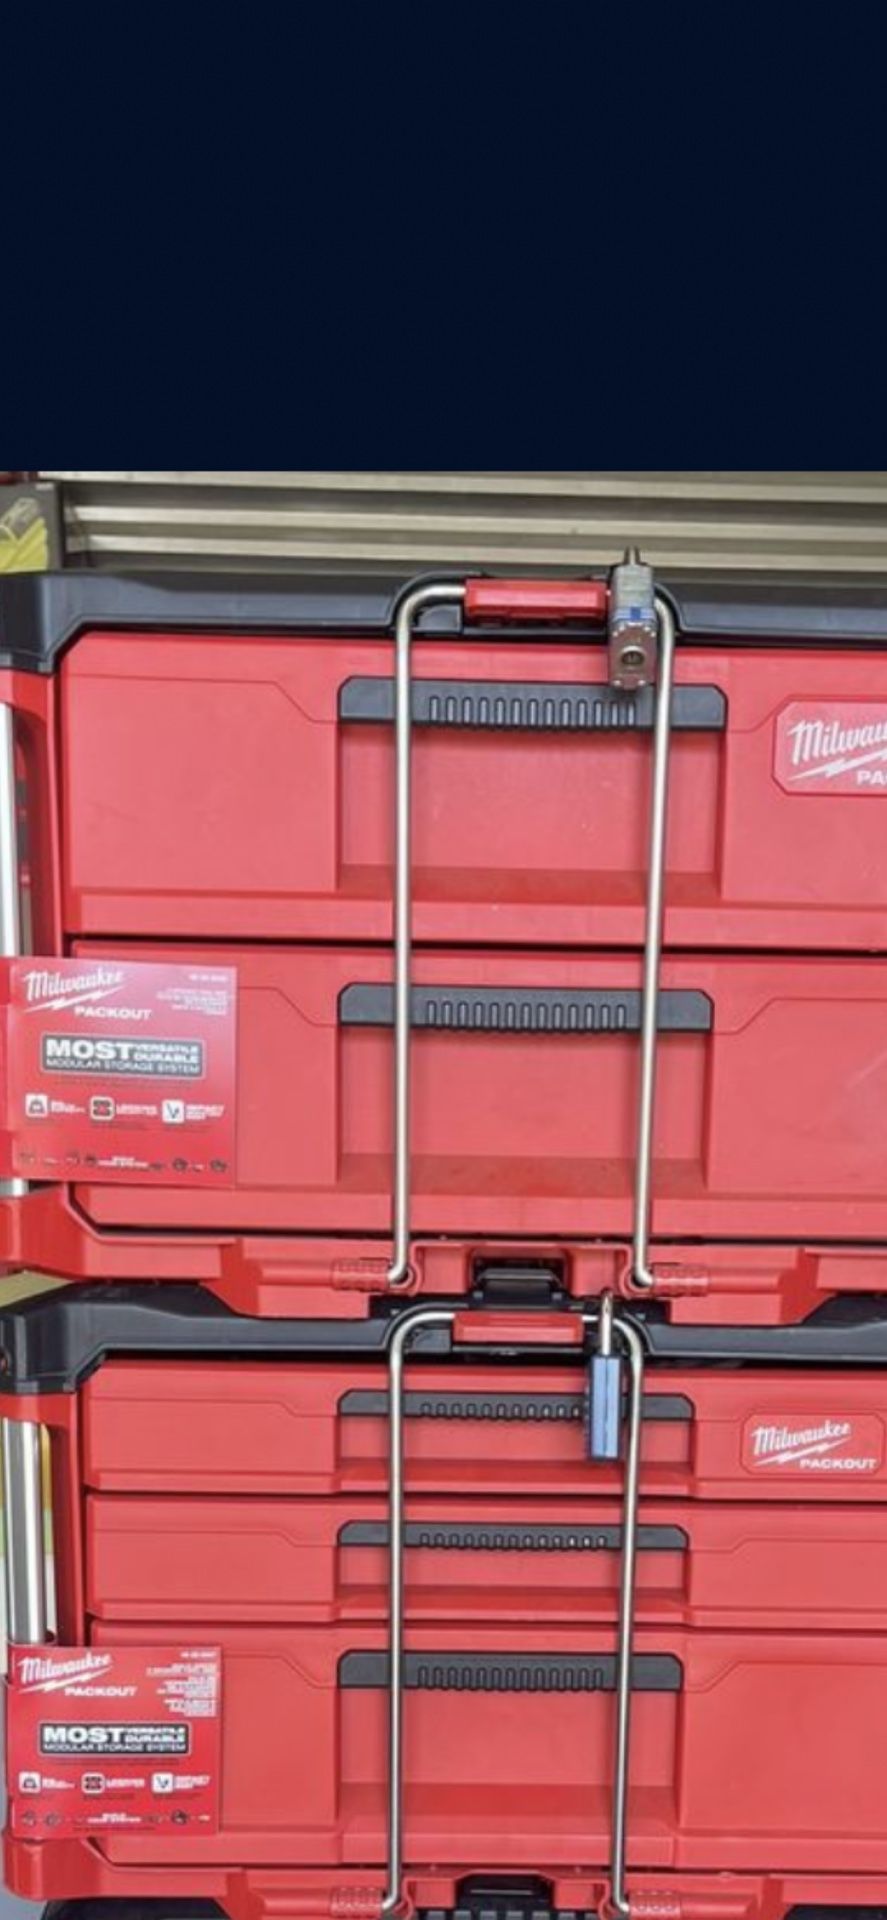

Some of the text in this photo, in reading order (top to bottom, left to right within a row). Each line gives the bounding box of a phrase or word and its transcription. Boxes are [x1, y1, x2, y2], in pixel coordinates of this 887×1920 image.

[857, 770, 887, 785] PA
[24, 968, 123, 1002] Milwaukee
[74, 1006, 152, 1020] PACKOUT
[46, 1038, 133, 1060] MOST
[134, 1043, 199, 1054] VERSATILE
[133, 1052, 199, 1064] DURABLE
[46, 1058, 199, 1073] MODULAR STORAGE SYSTEM
[752, 1419, 852, 1456] Milwaukee
[800, 1458, 877, 1469] PACKOUT
[18, 1652, 112, 1684] Milwaukee
[64, 1686, 138, 1697] PACKOUT
[44, 1726, 125, 1743] MOST
[125, 1734, 186, 1743] DURABLE
[44, 1743, 186, 1752] MODULAR STORAGE SYSTEM
